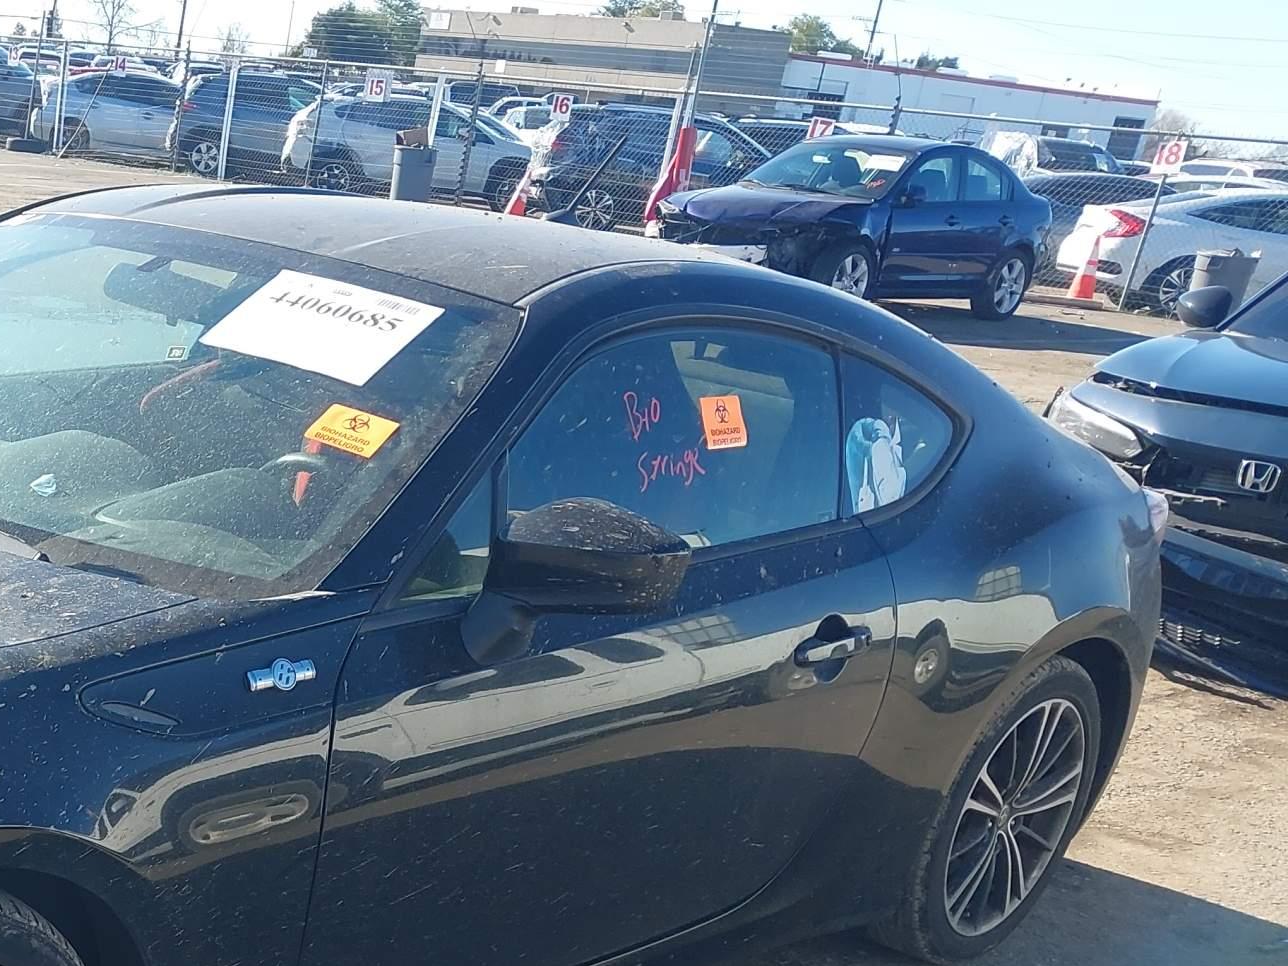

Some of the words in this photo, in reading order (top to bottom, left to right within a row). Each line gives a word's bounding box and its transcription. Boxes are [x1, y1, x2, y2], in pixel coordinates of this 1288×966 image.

[114, 56, 126, 72] 14
[369, 79, 384, 96] 15
[553, 96, 570, 114] 16
[809, 118, 833, 138] 17
[1156, 143, 1181, 165] 18
[270, 291, 404, 332] 44060685
[320, 425, 371, 446] BIOHAZARD
[710, 427, 741, 436] BIOHAZARD
[314, 431, 365, 453] BIOPELIGRO
